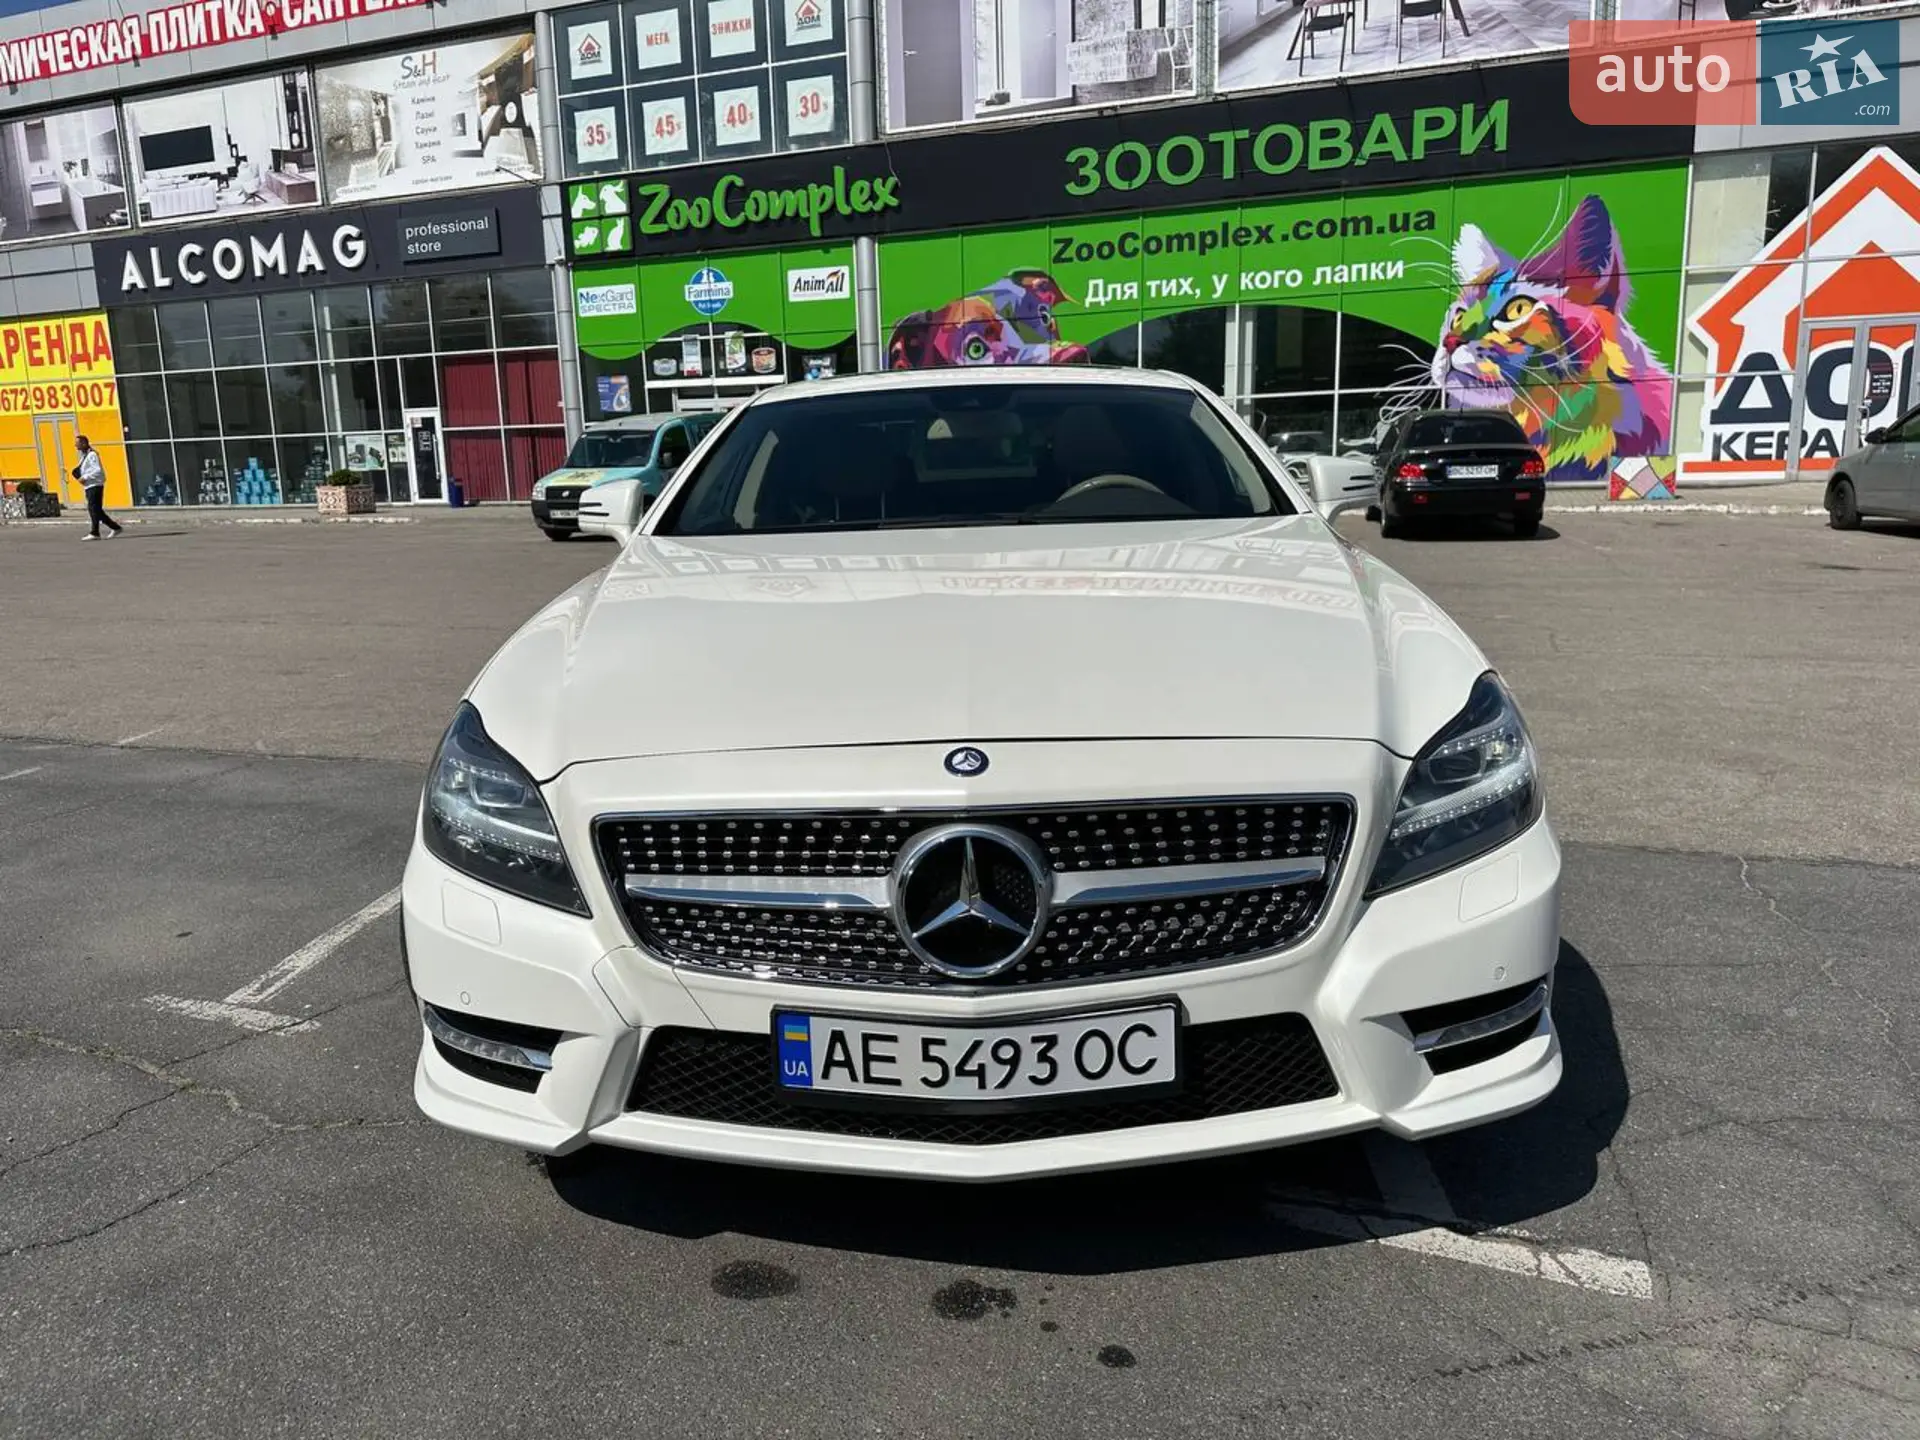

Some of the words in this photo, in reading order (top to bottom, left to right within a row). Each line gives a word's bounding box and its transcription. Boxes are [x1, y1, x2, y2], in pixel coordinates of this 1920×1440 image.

[148, 0, 264, 53] ПЛИТКА
[646, 32, 670, 46] МЕГА
[711, 18, 752, 35] ЗНИЖКИ
[401, 51, 437, 79] S&H
[1064, 98, 1510, 197] ЗООТОВАРИ
[638, 166, 899, 237] ZooComplex
[405, 216, 489, 240] professional
[1052, 209, 1437, 265] ZooComplex.com.ua
[121, 224, 368, 292] ALCOMAG
[407, 241, 442, 254] store
[579, 289, 634, 304] NexGard
[688, 284, 730, 299] Farmina
[1084, 279, 1139, 307] Для
[1146, 275, 1201, 299] тих,
[1212, 272, 1229, 298] у
[1240, 269, 1303, 291] кого
[1312, 260, 1405, 286] лапки
[580, 302, 634, 314] SPECTRA
[0, 320, 112, 372] РЕНДА
[1711, 428, 1848, 462] КЕРА
[783, 1059, 808, 1077] UA
[820, 1029, 902, 1085] AE
[919, 1034, 1060, 1090] 5493
[1073, 1023, 1158, 1081] OC
